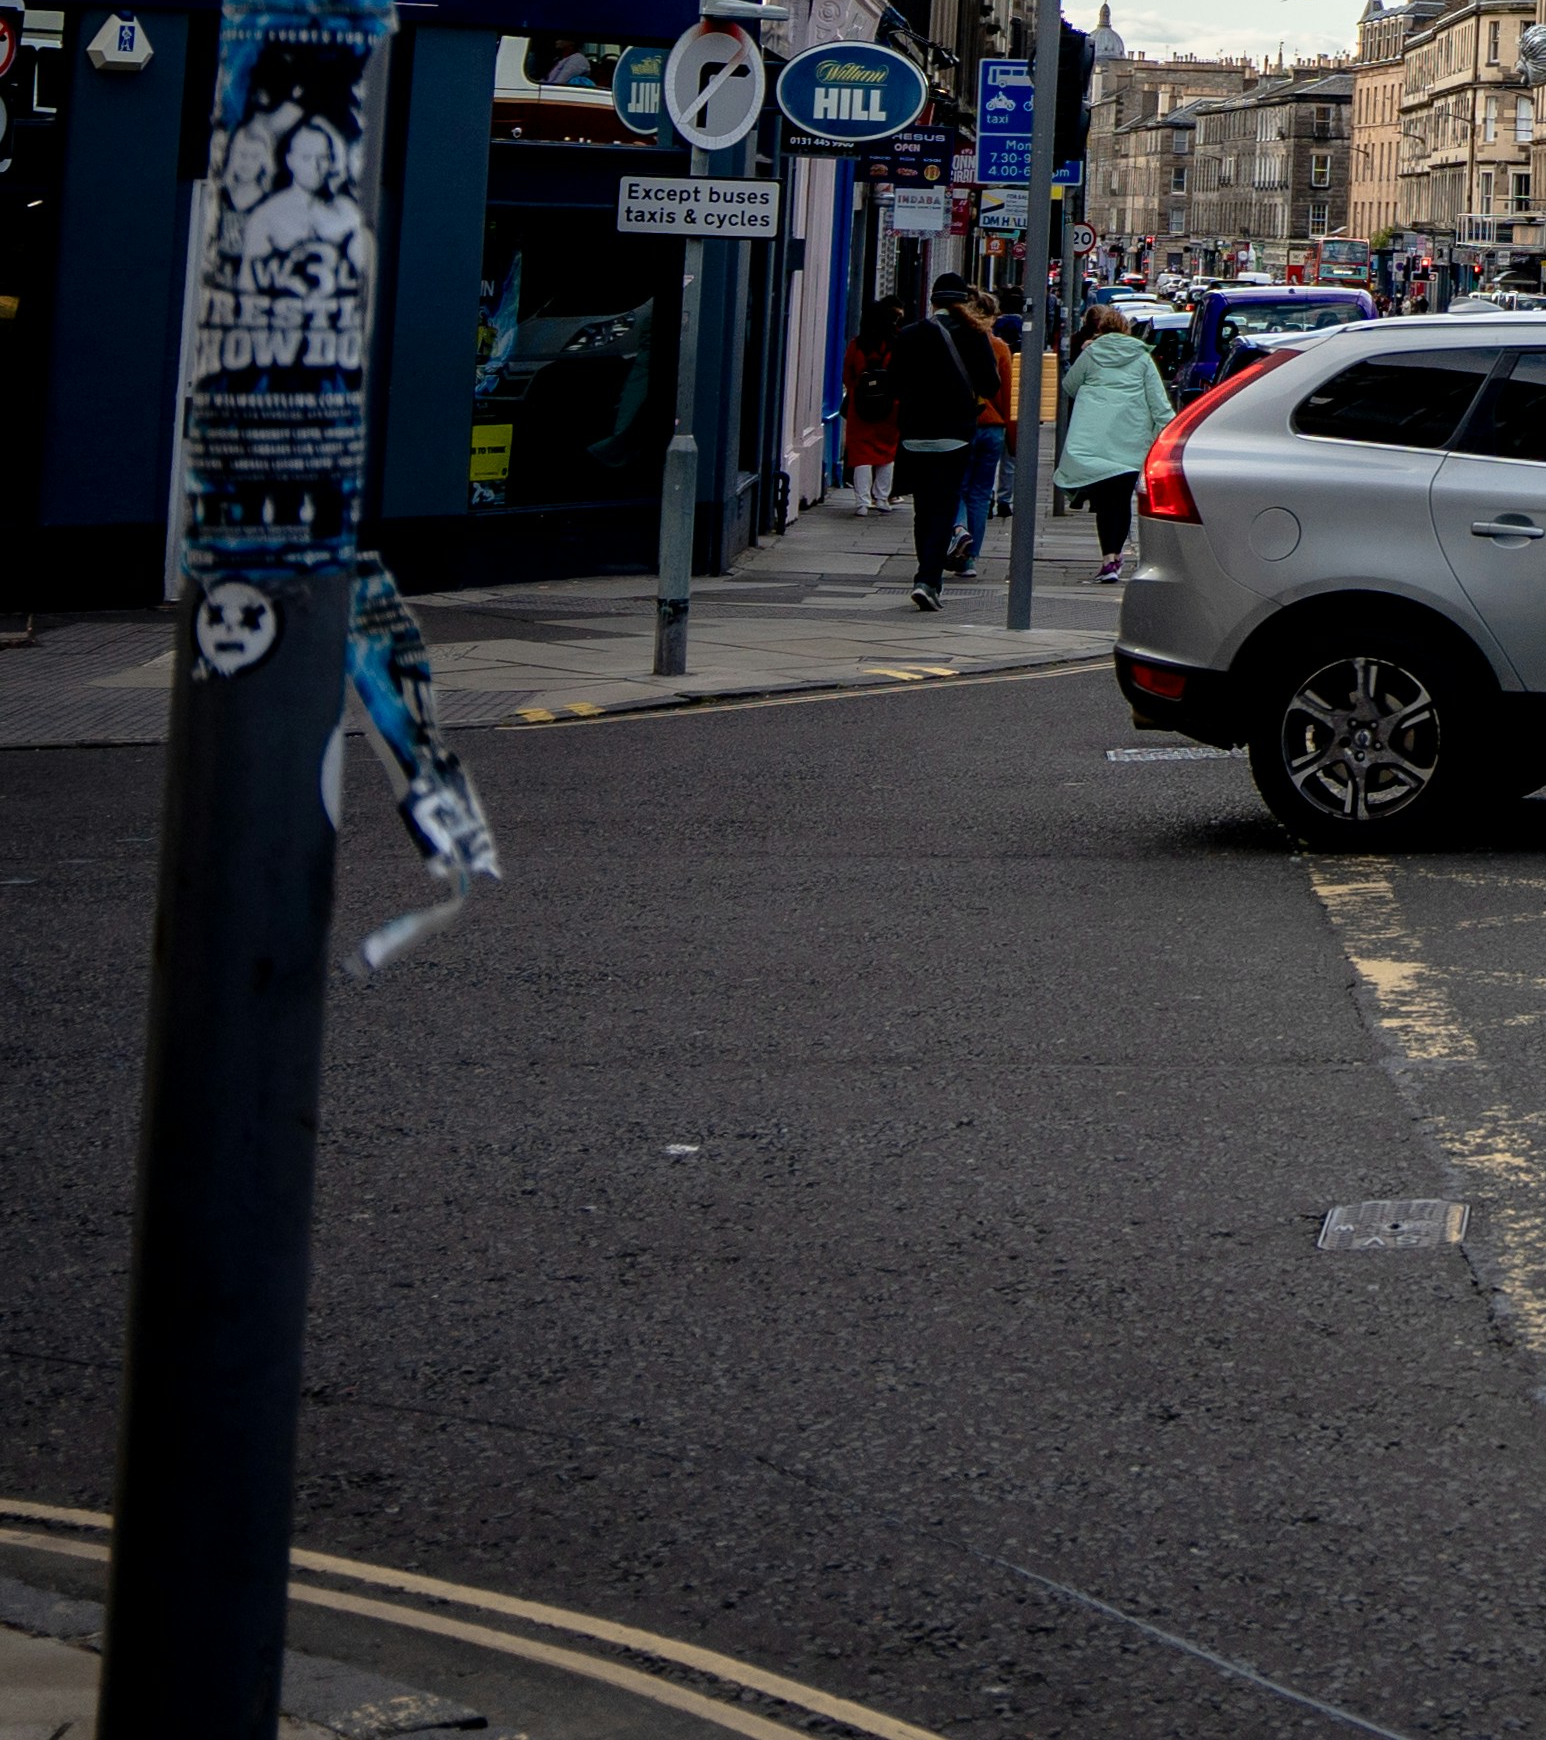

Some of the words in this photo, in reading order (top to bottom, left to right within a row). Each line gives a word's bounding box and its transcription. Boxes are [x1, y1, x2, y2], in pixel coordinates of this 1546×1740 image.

[816, 59, 890, 85] William
[813, 87, 887, 121] HILL
[987, 114, 1009, 124] taxi
[627, 183, 701, 204] Except
[708, 182, 770, 205] buses
[625, 206, 676, 223] taxis
[684, 209, 698, 225] &
[703, 208, 770, 229] cycles
[1073, 231, 1093, 245] 20
[200, 296, 360, 329] RESTL
